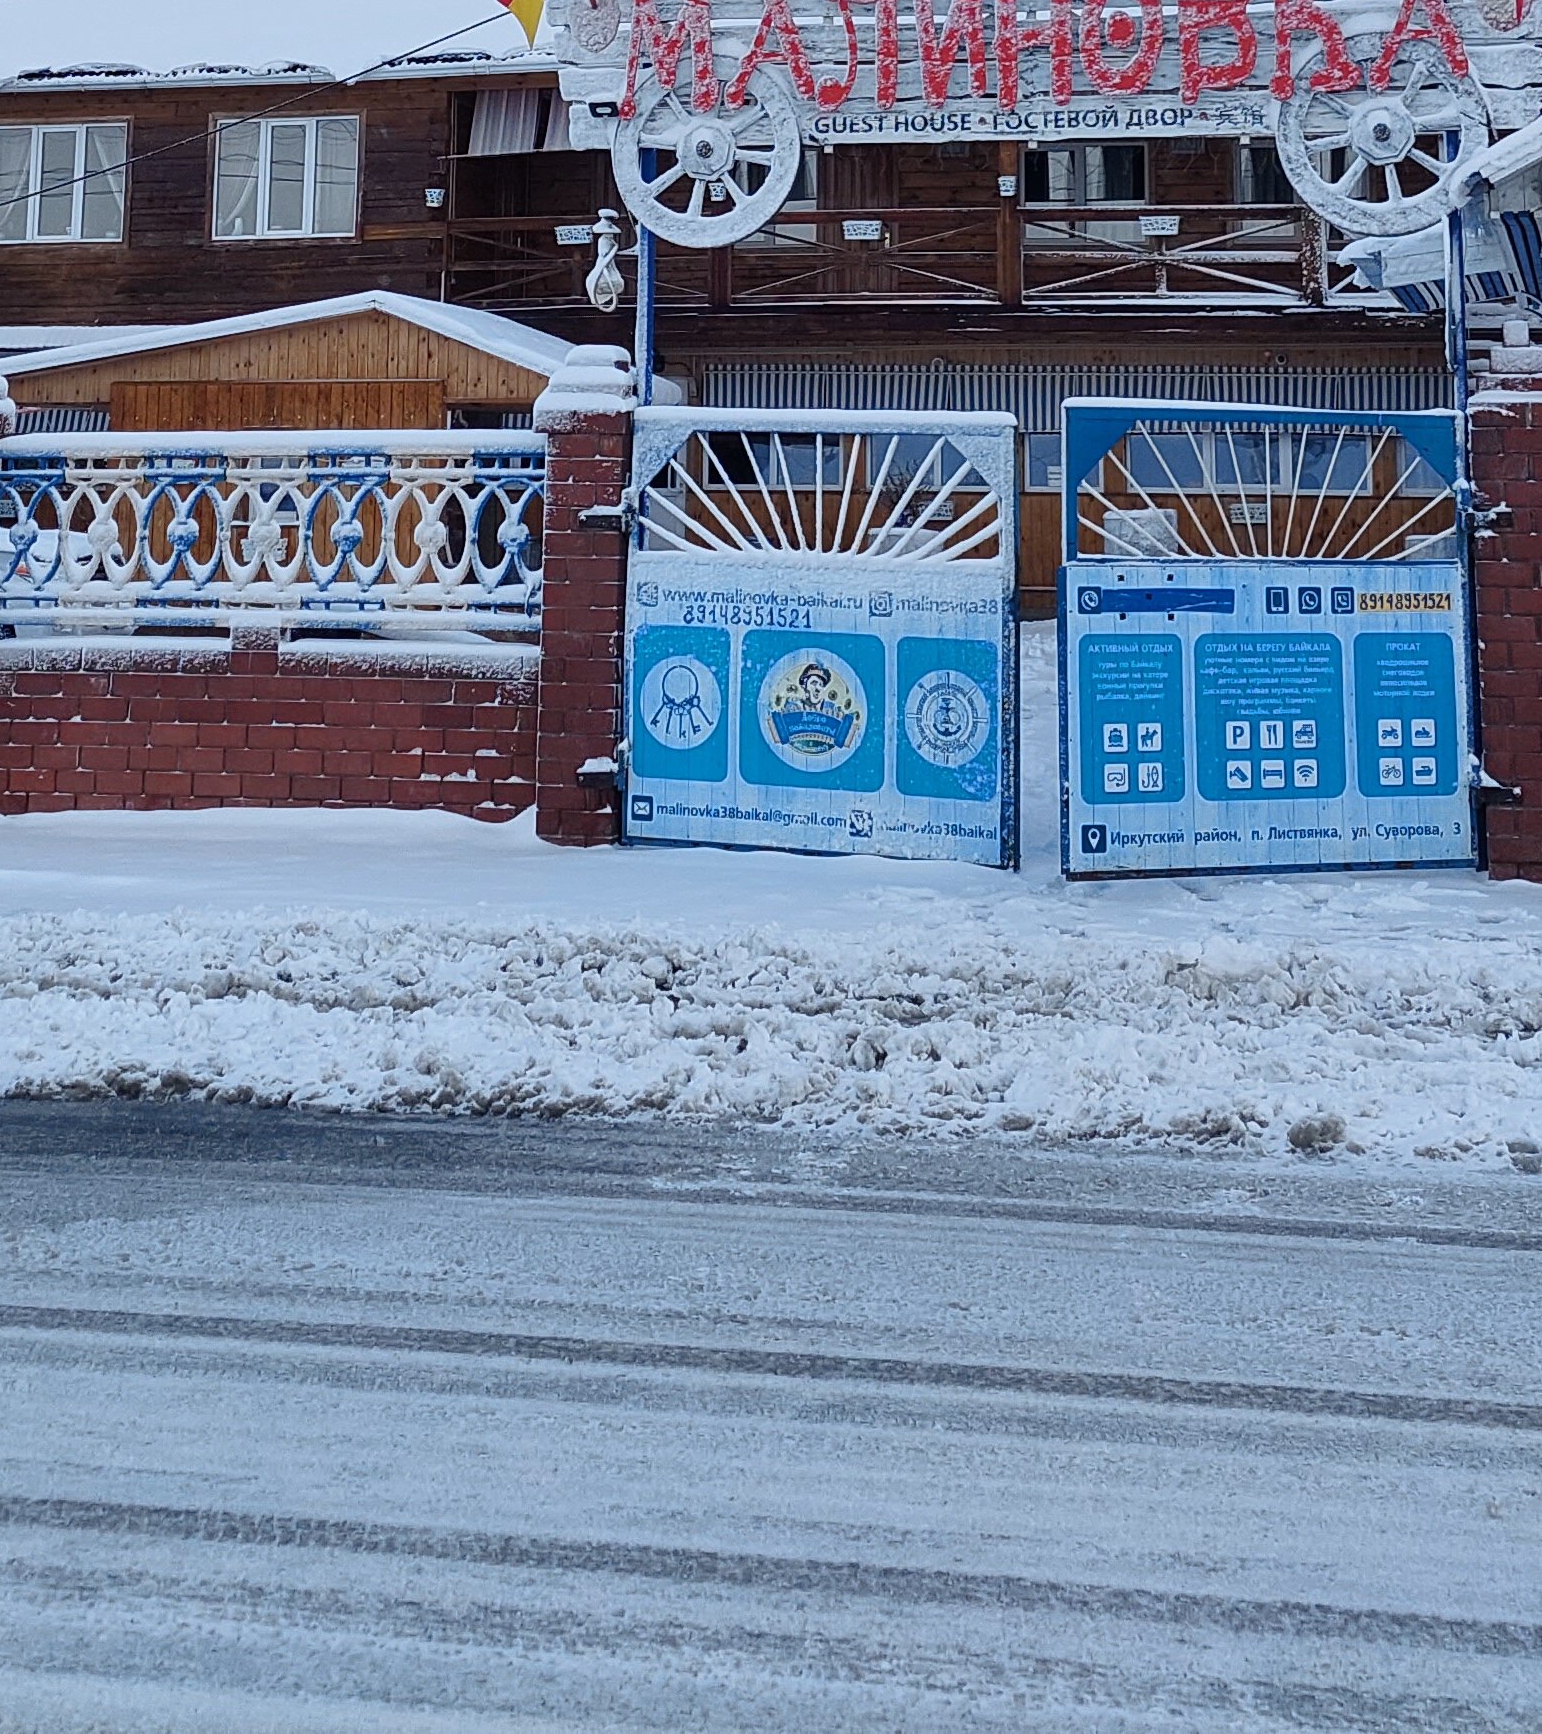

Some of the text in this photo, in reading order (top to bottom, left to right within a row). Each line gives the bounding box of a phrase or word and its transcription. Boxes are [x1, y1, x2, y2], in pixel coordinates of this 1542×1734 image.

[814, 112, 971, 133] GUEST HOUSE
[993, 105, 1193, 131] ГОСТЕВОЙ ДВОР
[1359, 593, 1451, 611] 89148951521
[683, 604, 812, 628] 89148951521
[1088, 642, 1173, 653] АКТИВНЫЙ ОТДЫХ
[1205, 641, 1331, 653] ОТДЫХ НА БЕРЕГУ БАЙКАЛА
[1385, 642, 1421, 652] ПРОКАТ
[1110, 821, 1462, 848] Иркутский район, п. Листвянка, ул. Суворова, 3
